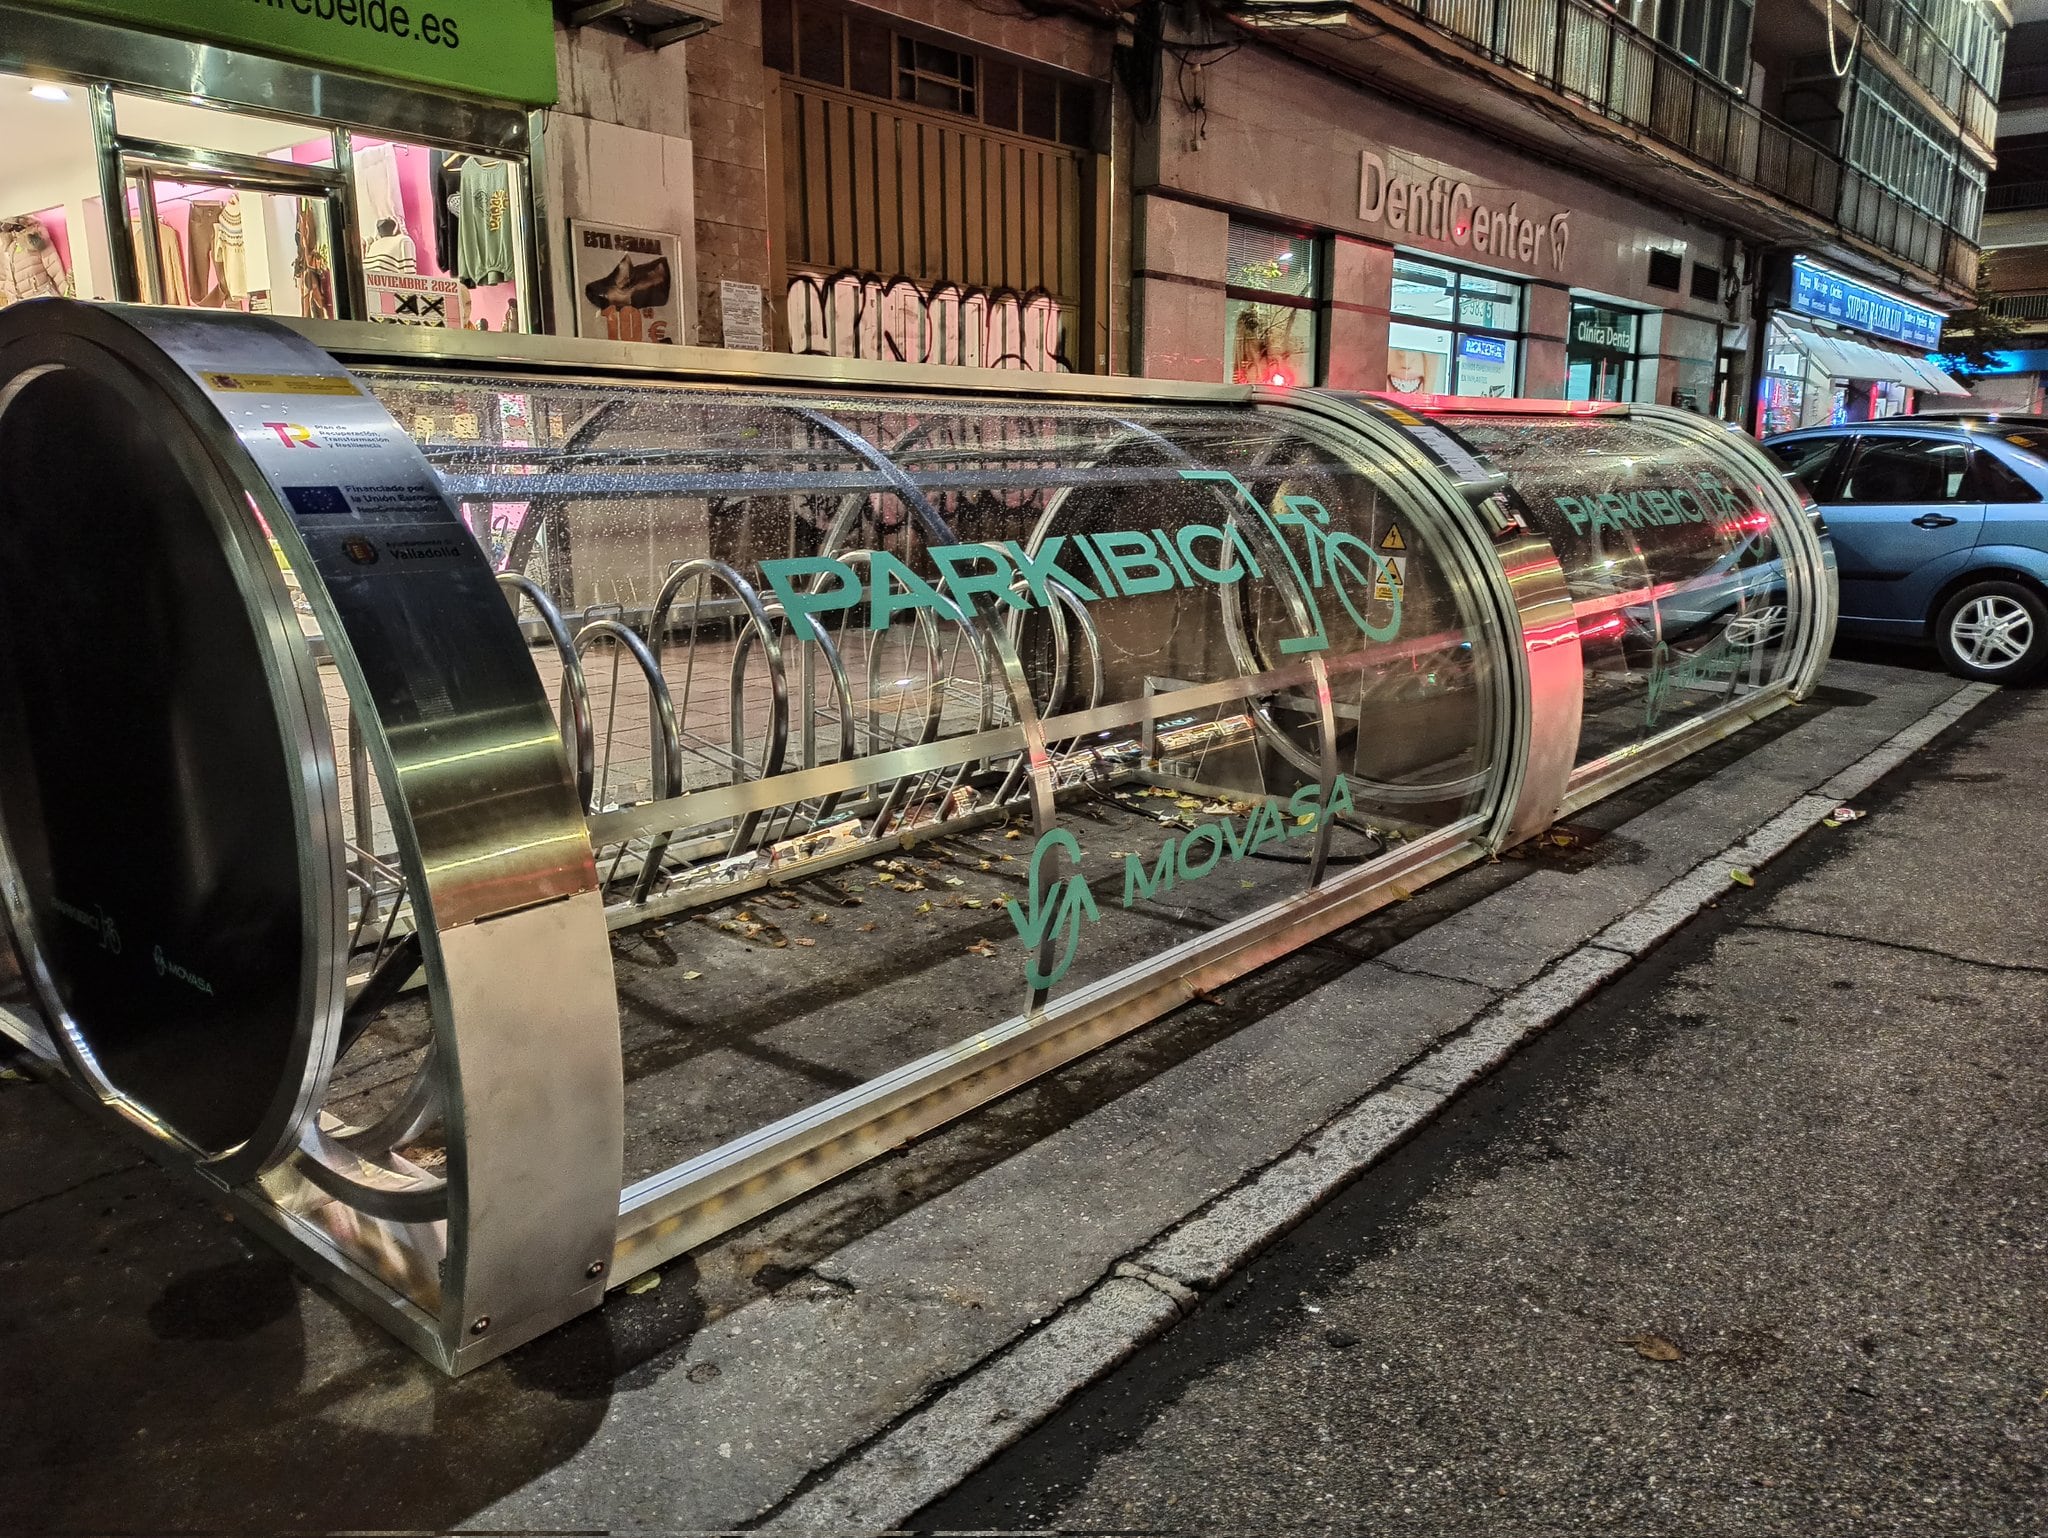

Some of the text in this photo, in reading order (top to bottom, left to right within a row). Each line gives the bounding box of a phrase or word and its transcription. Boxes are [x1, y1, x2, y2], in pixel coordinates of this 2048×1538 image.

[1359, 150, 1545, 265] DentiCenter
[583, 230, 613, 250] ESTA
[366, 273, 458, 294] NOVIEMBRE 2022
[601, 304, 643, 342] 10
[1846, 294, 1870, 324] SUPER
[1868, 301, 1891, 331] BAZAR
[1578, 320, 1631, 349] Clínica Denta
[345, 485, 425, 494] Financiado por
[362, 494, 396, 503] Unión
[1554, 488, 1711, 536] PARKIBICI
[389, 546, 460, 560] Valladolid
[758, 522, 1264, 641] PARKIBICI
[1123, 772, 1355, 908] MOVASA
[168, 961, 214, 997] MOVASA
